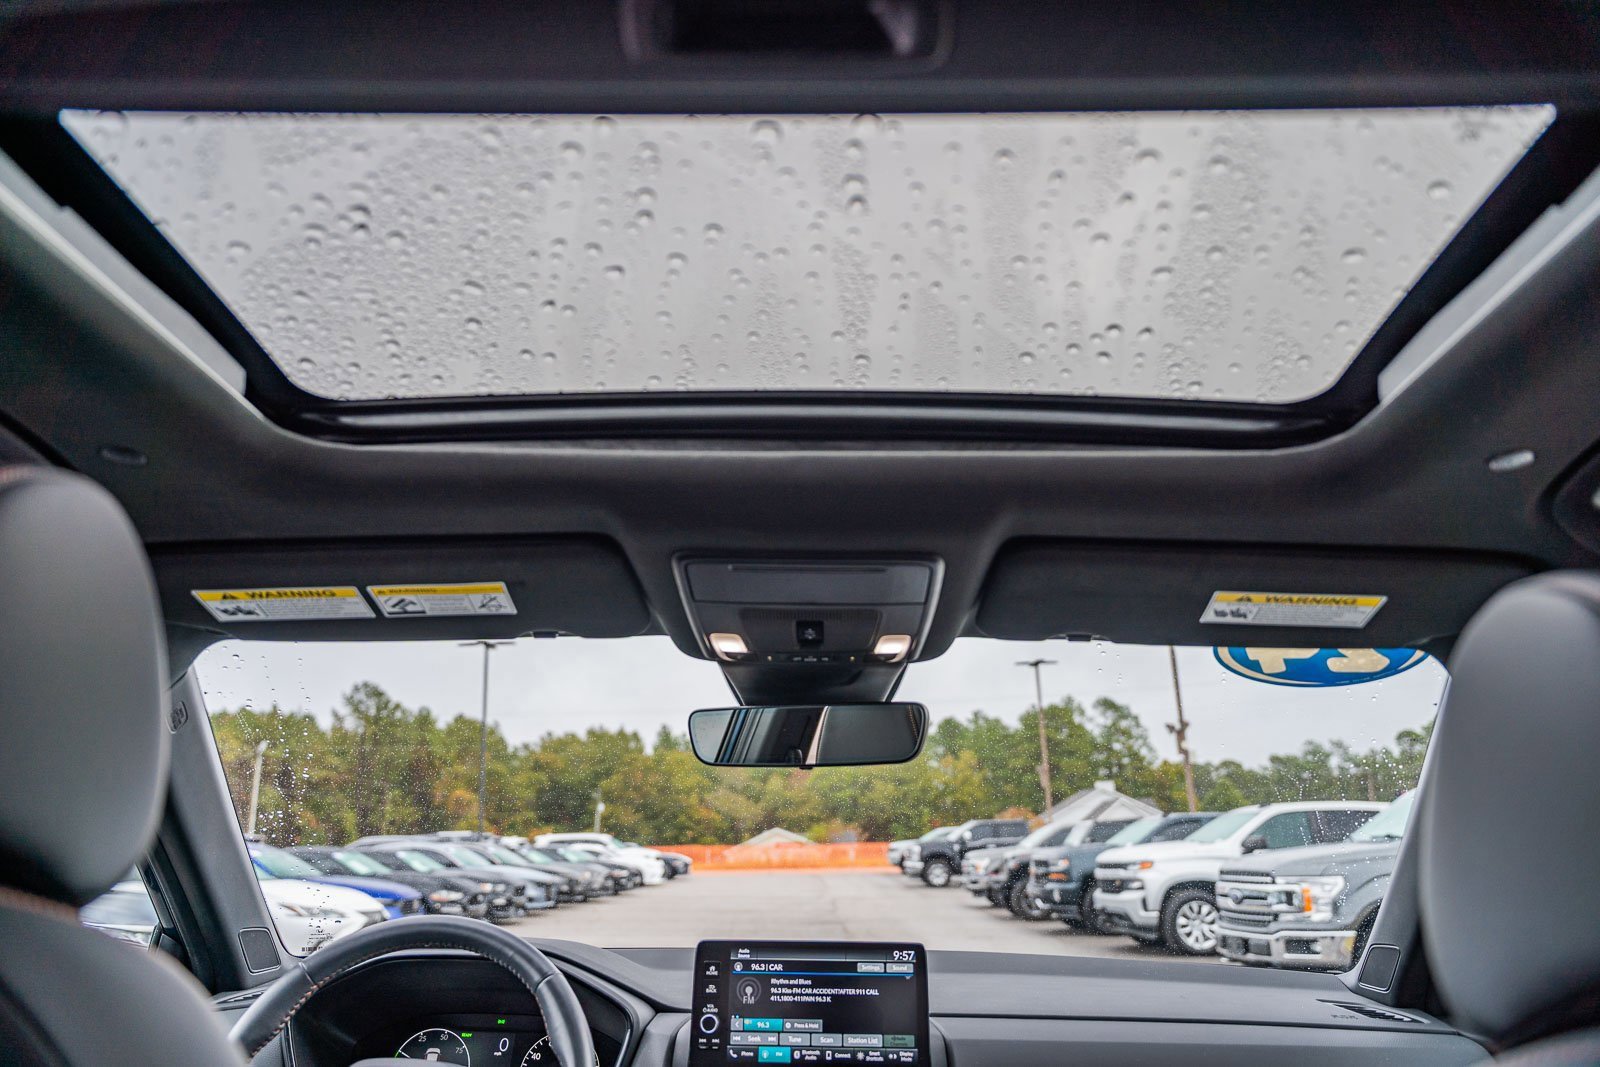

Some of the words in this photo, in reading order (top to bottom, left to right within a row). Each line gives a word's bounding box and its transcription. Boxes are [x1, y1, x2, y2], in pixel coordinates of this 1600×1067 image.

[245, 589, 337, 599] WARNING
[1264, 595, 1358, 605] WARNING
[893, 951, 915, 961] 9:57
[751, 963, 765, 971] 96.3
[743, 996, 755, 1005] FM
[757, 1021, 770, 1029] 96.3
[418, 1035, 427, 1043] 25
[848, 1036, 868, 1044] Station
[499, 1037, 510, 1052] 0
[531, 1052, 542, 1061] 40
